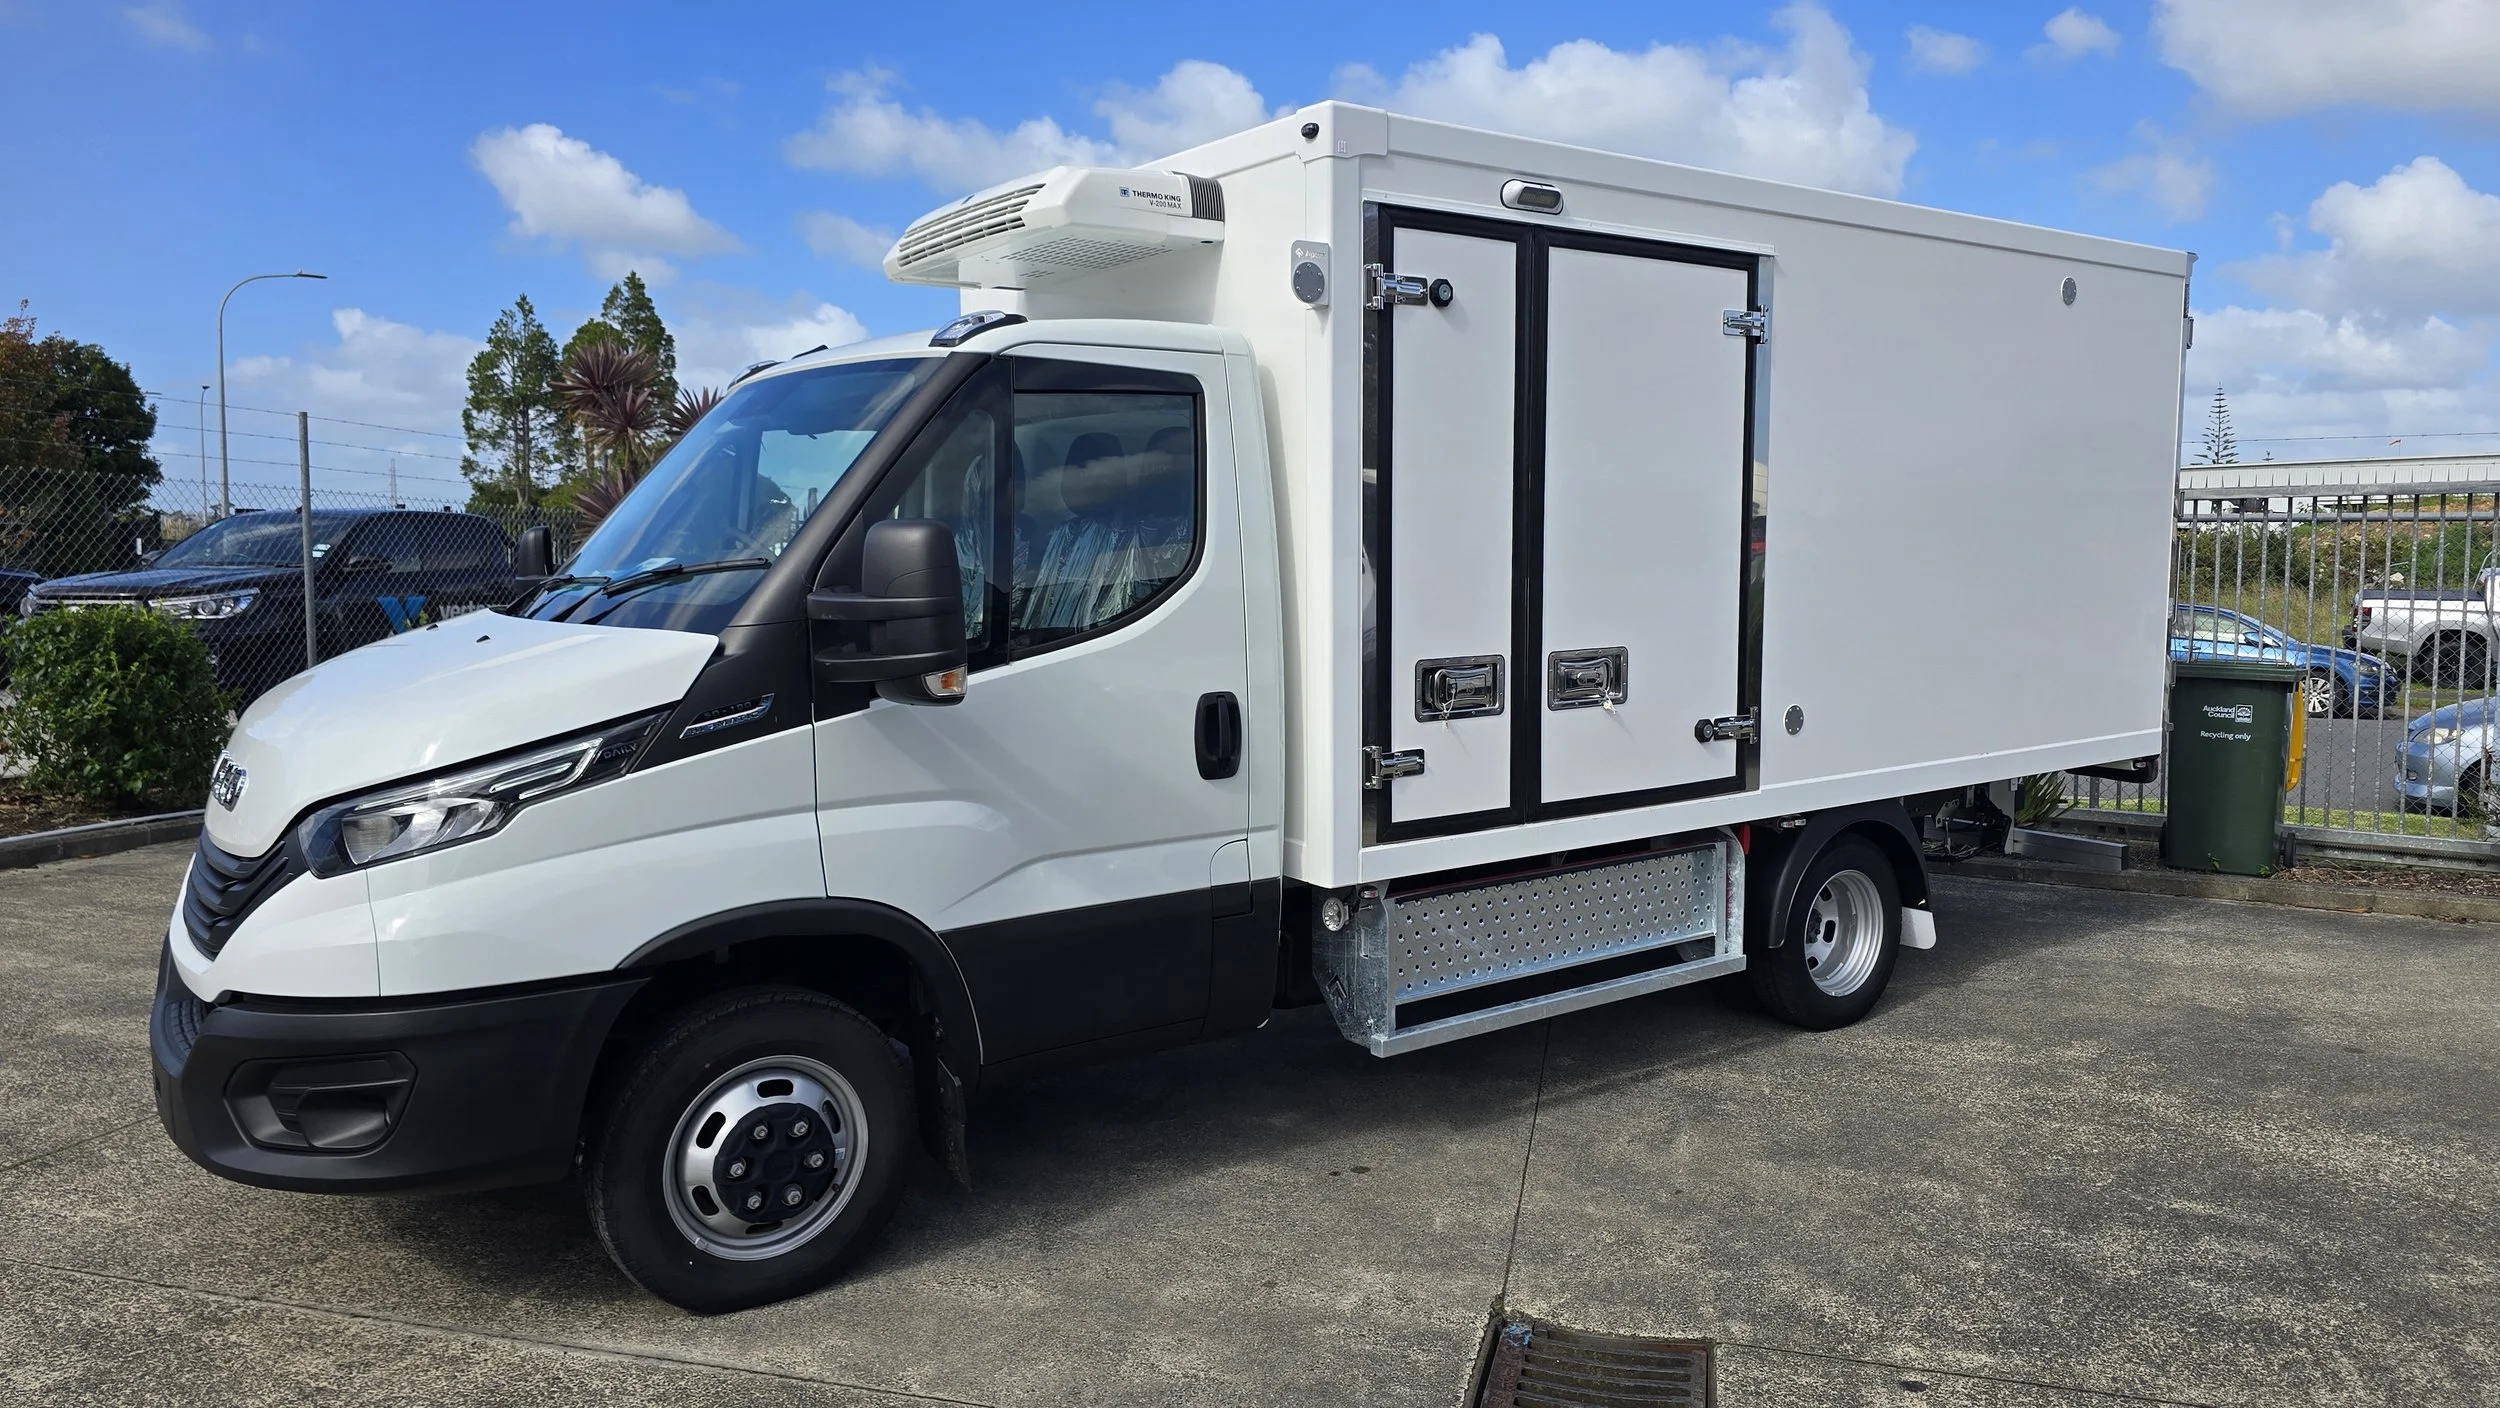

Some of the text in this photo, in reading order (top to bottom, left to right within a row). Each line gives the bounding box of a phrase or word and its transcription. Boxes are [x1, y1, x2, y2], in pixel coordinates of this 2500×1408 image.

[1132, 190, 1163, 200] THERMO
[1164, 194, 1182, 202] KING
[1149, 200, 1167, 208] V-200
[2202, 705, 2236, 713] Auckland
[2207, 711, 2235, 719] Council
[2200, 730, 2252, 742] Recycling only
[603, 743, 637, 759] DAILY
